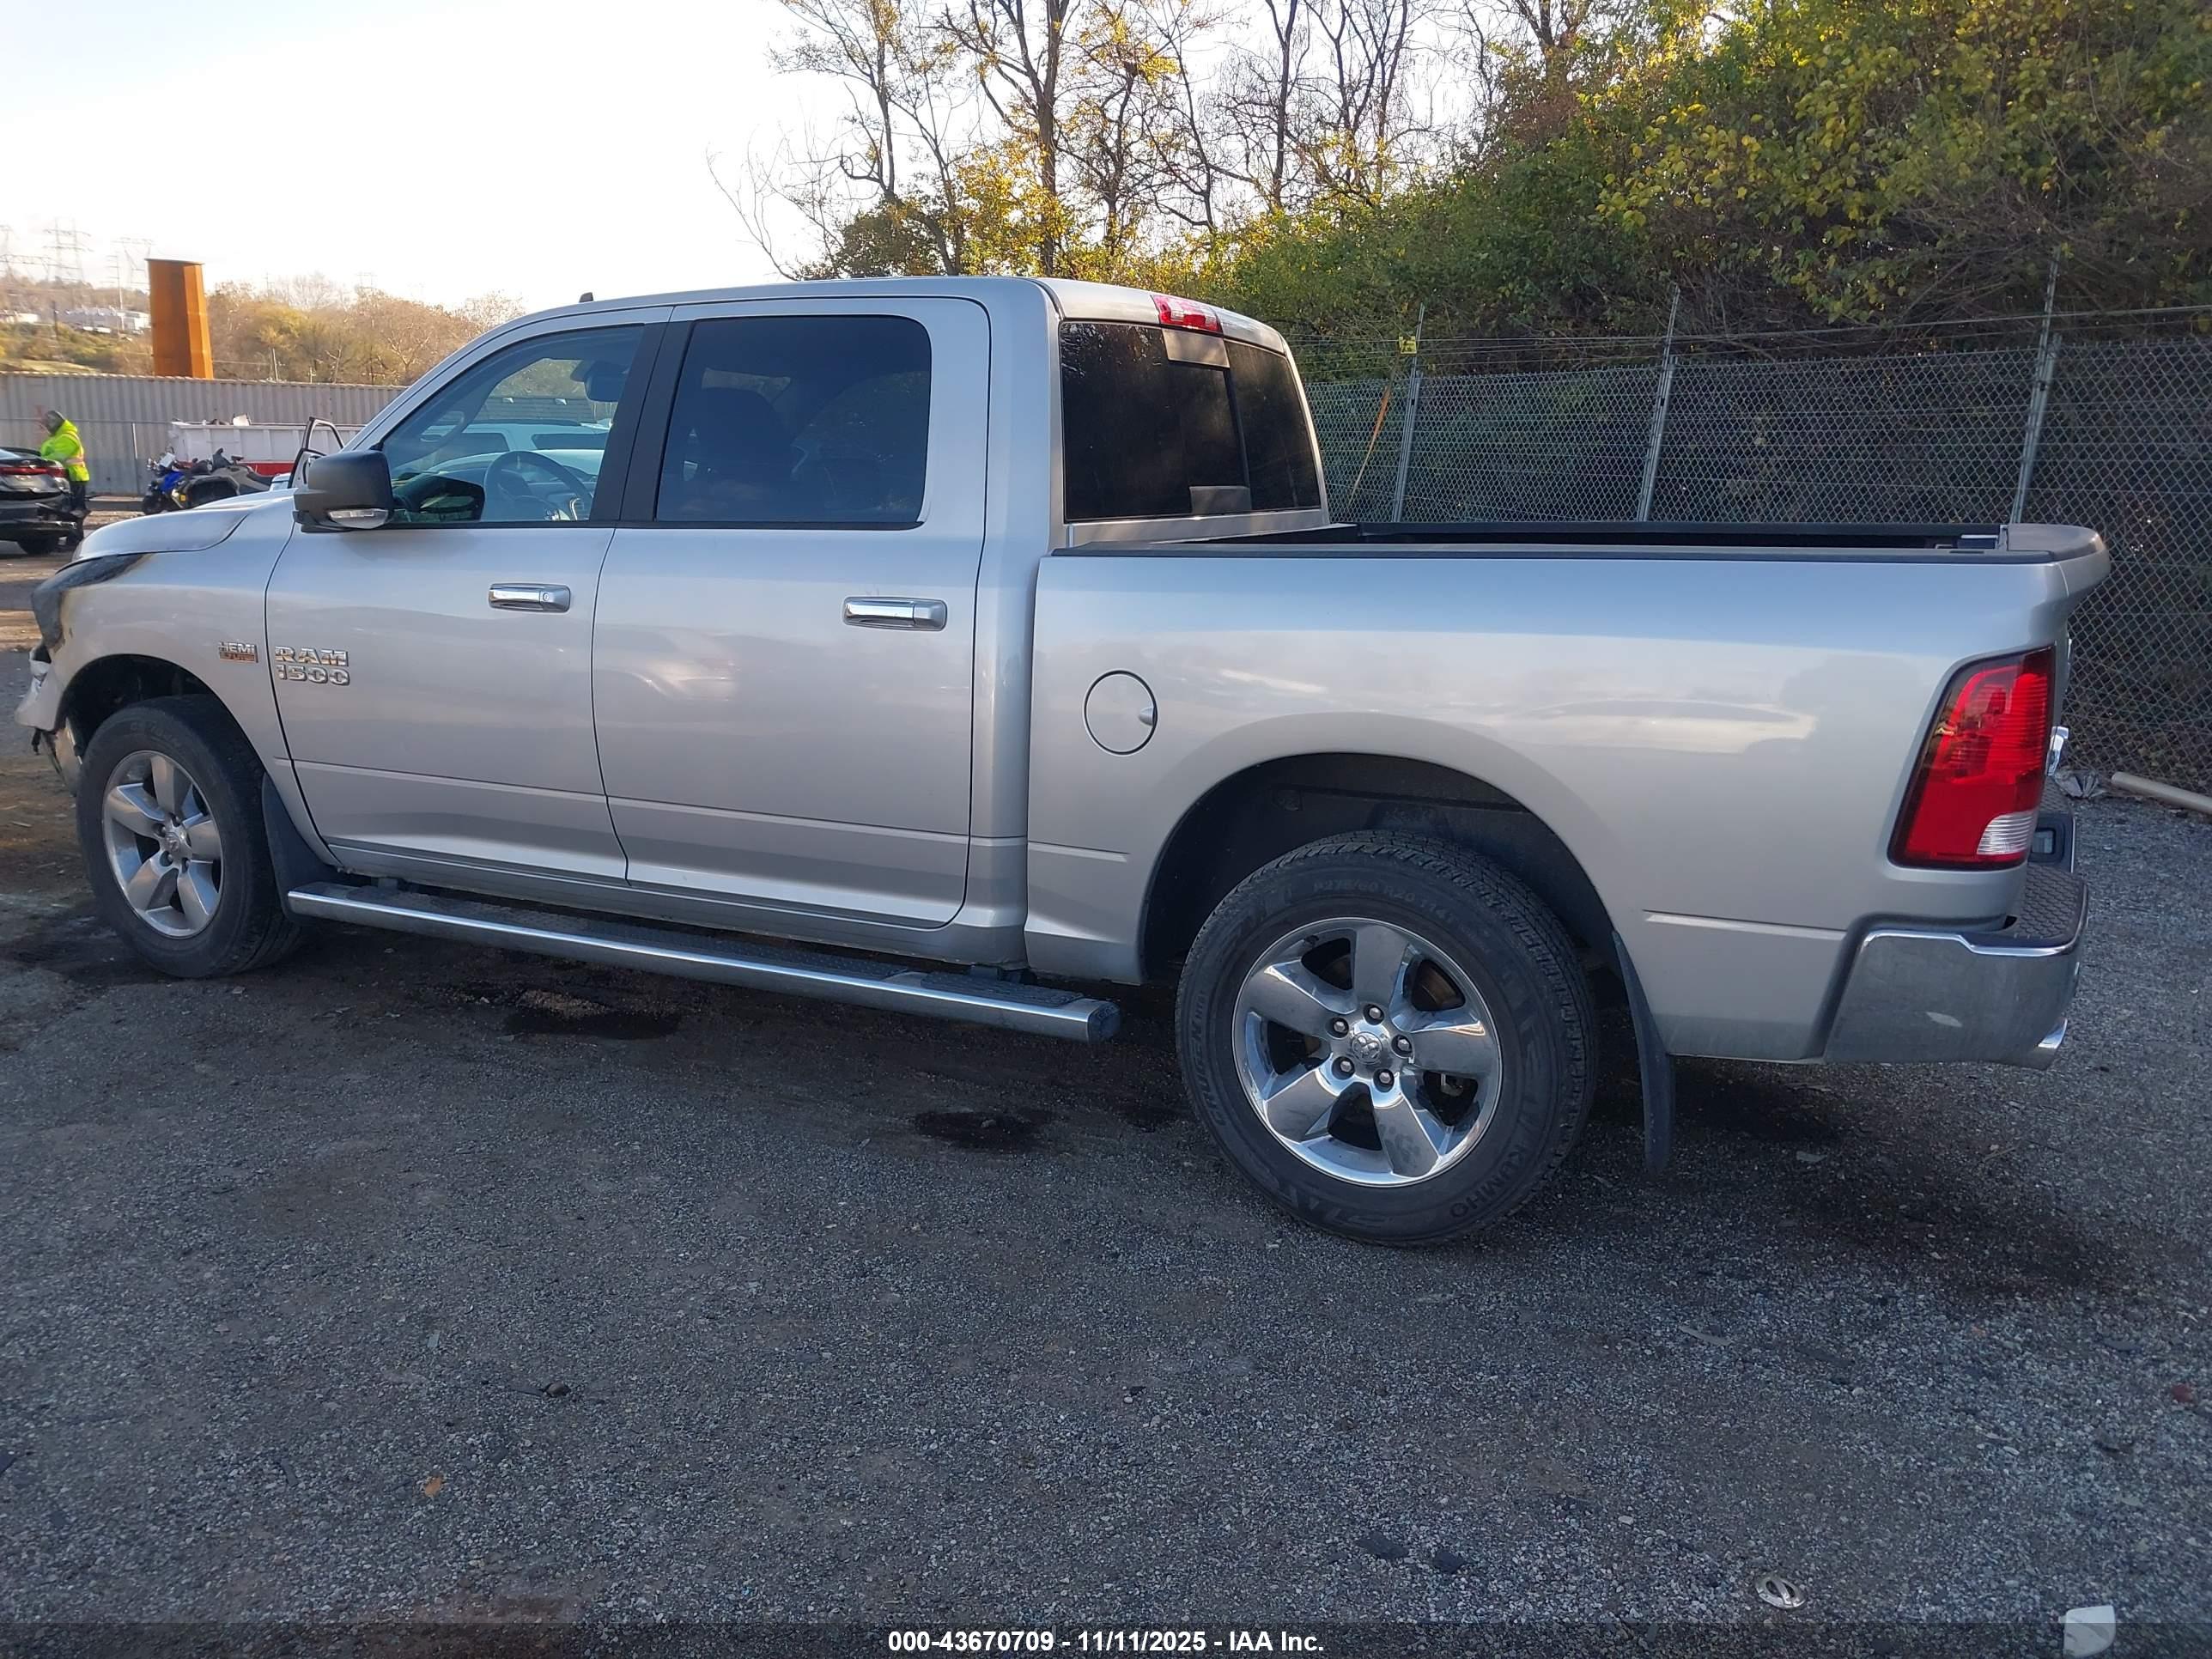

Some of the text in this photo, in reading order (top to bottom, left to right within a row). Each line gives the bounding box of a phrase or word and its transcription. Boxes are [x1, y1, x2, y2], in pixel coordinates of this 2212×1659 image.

[218, 641, 257, 653] HEMI
[275, 646, 349, 666] RAM
[276, 664, 350, 686] 1500
[1449, 1145, 1530, 1218] KUMHO
